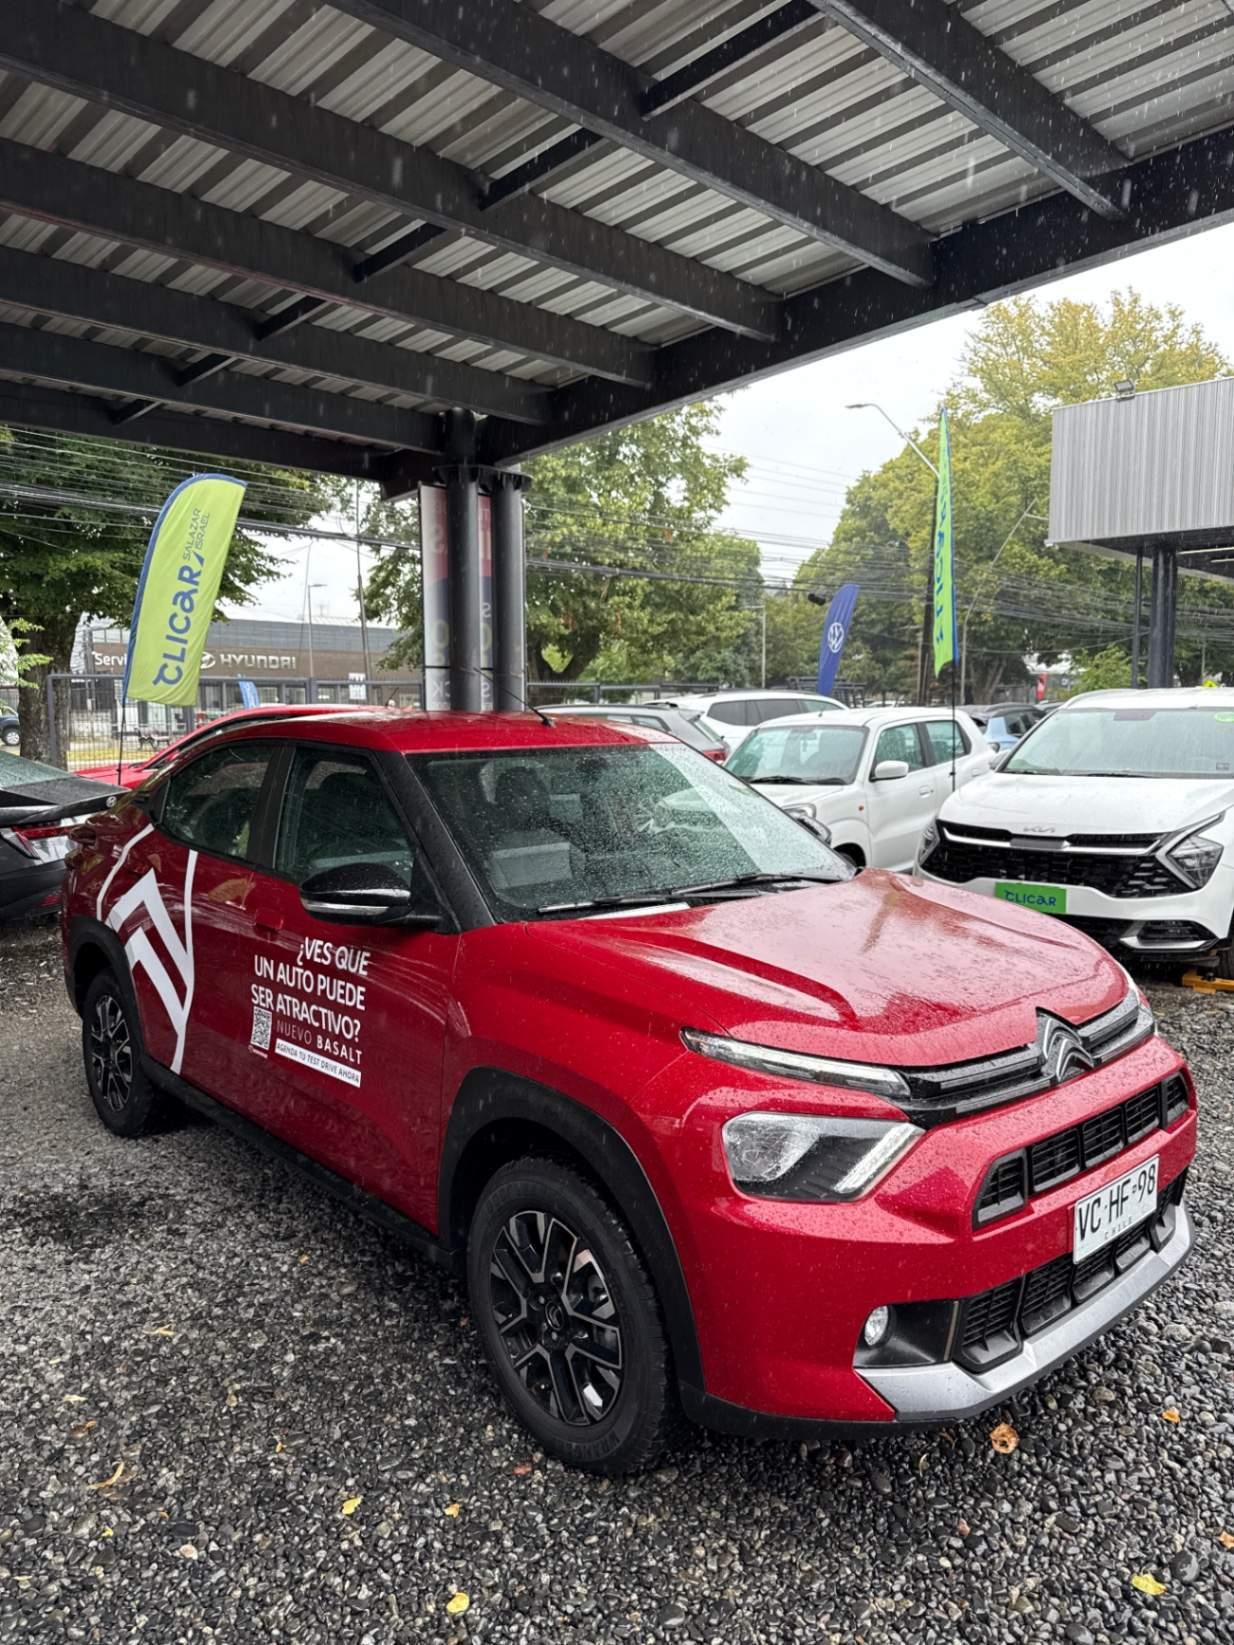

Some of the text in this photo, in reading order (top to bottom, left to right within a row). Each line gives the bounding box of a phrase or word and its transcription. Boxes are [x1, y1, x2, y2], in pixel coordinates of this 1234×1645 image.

[183, 508, 201, 561] SALAZAR
[194, 512, 210, 550] ISRAEL
[94, 652, 127, 666] Servi
[220, 653, 297, 670] HYUNDAI
[297, 937, 371, 976] ¿VES QUE
[254, 954, 366, 1011] UN AUTO PUEDE
[251, 984, 361, 1042] SER ATRACTIVO?
[276, 1020, 363, 1065] NUEVO BASALT
[307, 1054, 321, 1067] TEST
[320, 1061, 338, 1074] DRIVE
[338, 1067, 360, 1083] AHORA
